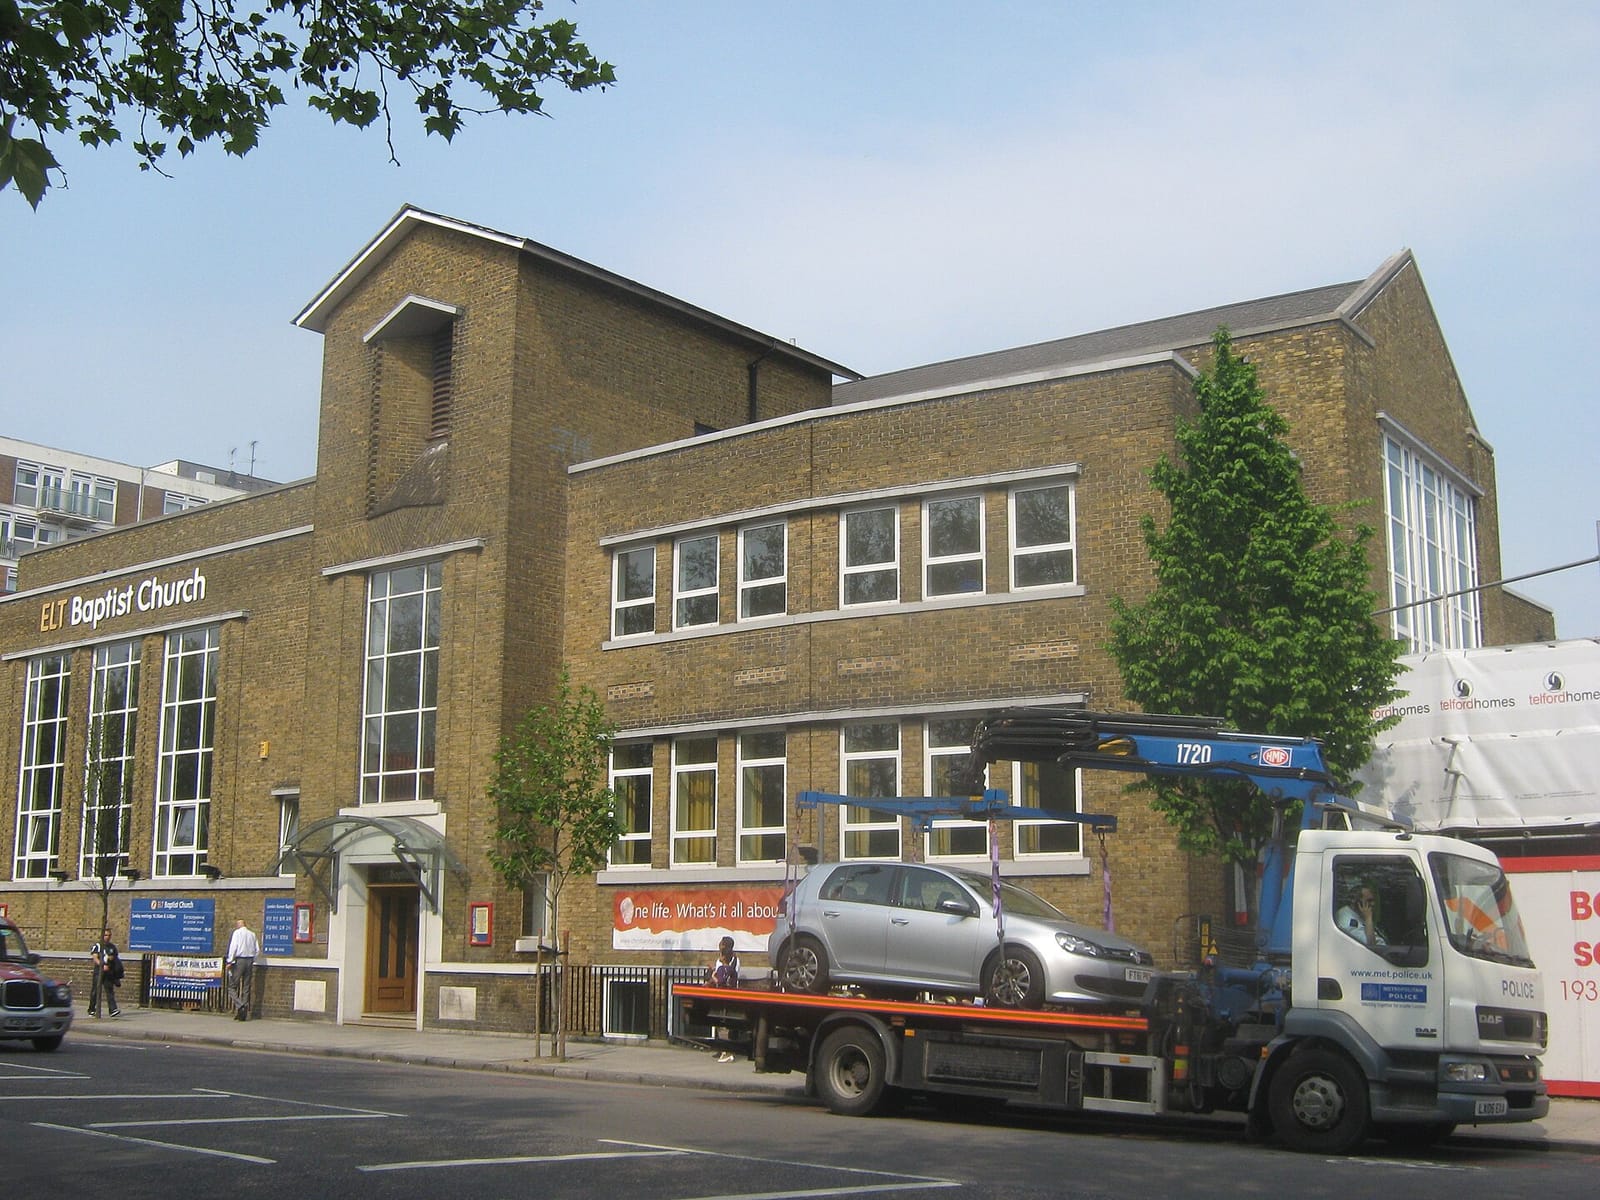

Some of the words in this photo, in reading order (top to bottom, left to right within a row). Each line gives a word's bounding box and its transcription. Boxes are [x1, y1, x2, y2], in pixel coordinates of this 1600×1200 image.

[40, 599, 68, 632] ELT
[70, 584, 135, 630] Baptist
[137, 567, 207, 612] Church
[1439, 697, 1516, 711] telfordhomes
[1528, 690, 1600, 705] telfordhome
[1371, 704, 1431, 719] ordhomes
[1176, 743, 1212, 765] 1720
[1265, 751, 1286, 763] HMF
[164, 900, 179, 910] Baptist
[179, 901, 194, 909] Church
[651, 902, 673, 919] life.
[676, 902, 717, 919] What's
[719, 902, 727, 918] it
[730, 902, 743, 918] all
[746, 902, 778, 919] abou
[175, 960, 189, 968] CAR
[201, 960, 219, 969] SALE
[1350, 969, 1433, 980] www.met.police.uk
[1501, 979, 1535, 999] POLICE
[1560, 980, 1598, 1002] 193
[1388, 993, 1419, 1001] POLICE
[1479, 1014, 1503, 1024] DAF
